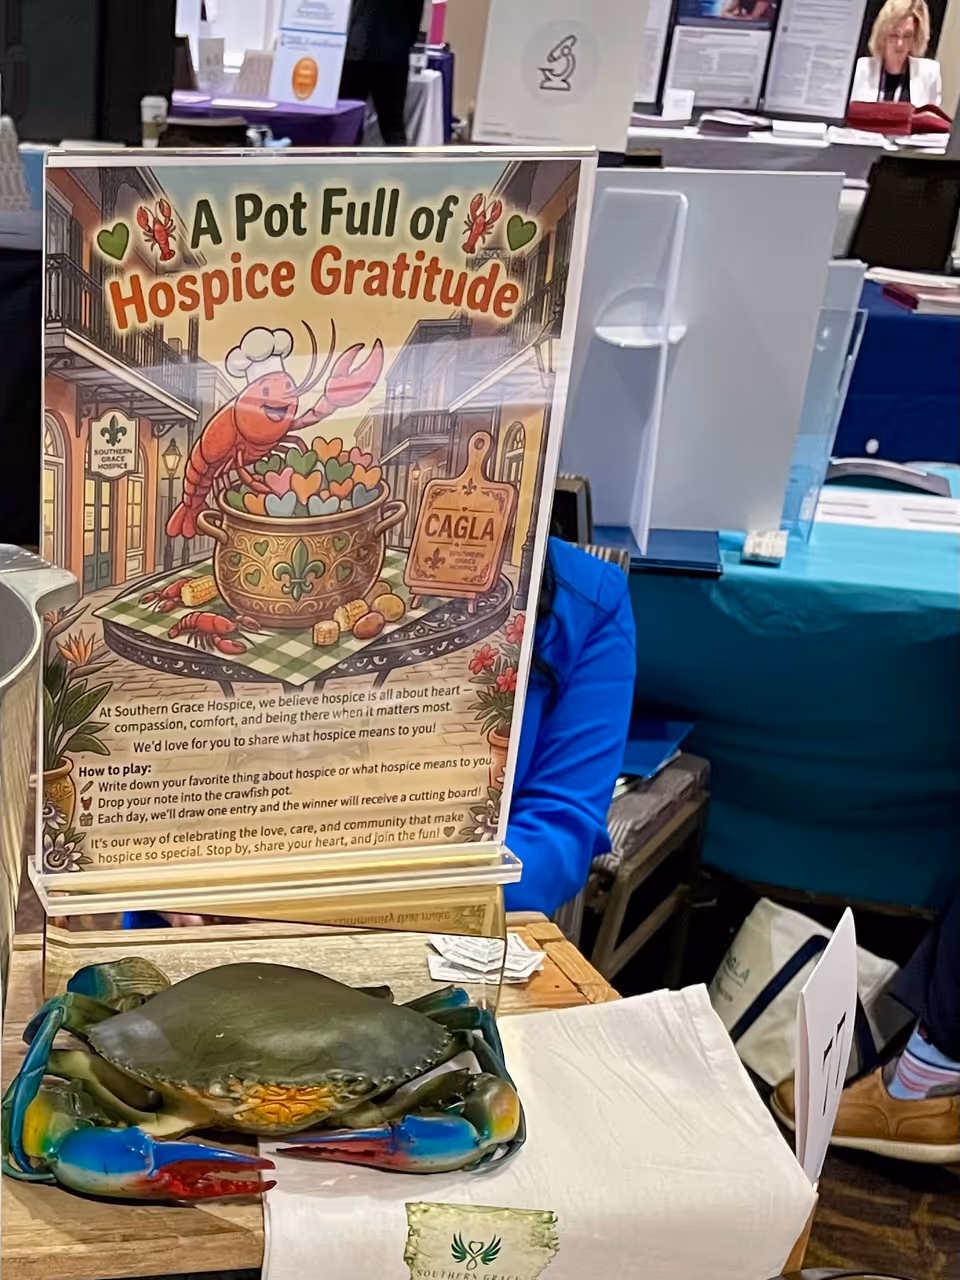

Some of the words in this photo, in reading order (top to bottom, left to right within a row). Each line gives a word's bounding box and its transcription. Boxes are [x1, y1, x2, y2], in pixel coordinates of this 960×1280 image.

[191, 199, 222, 248] A
[235, 192, 306, 241] Pot
[321, 188, 400, 237] Full
[410, 195, 459, 243] of
[109, 252, 295, 329] Hospice
[311, 245, 519, 318] Gratitude
[424, 513, 494, 541] CAGLA
[99, 707, 111, 718] At
[115, 705, 168, 717] Southern
[171, 702, 204, 714] Grace
[207, 699, 256, 713] Hospice,
[259, 699, 275, 708] we
[278, 694, 319, 707] believe
[322, 692, 365, 707] hospice
[368, 690, 376, 701] is
[380, 689, 393, 700] all
[396, 688, 428, 699] about
[431, 685, 460, 697] heart
[115, 719, 187, 733] compassion,
[190, 716, 238, 729] comfort,
[241, 714, 263, 725] and
[266, 712, 297, 725] being
[300, 707, 330, 720] there
[333, 706, 363, 719] when
[365, 705, 374, 716] it
[377, 704, 419, 715] matters
[423, 701, 453, 713] most.
[133, 740, 162, 753] We'd
[165, 739, 189, 751] love
[191, 737, 207, 749] for
[210, 738, 231, 750] you
[234, 736, 245, 747] to
[248, 733, 279, 745] share
[282, 730, 310, 743] what
[313, 728, 356, 743] hospice
[359, 727, 395, 737] means
[398, 725, 409, 735] to
[412, 723, 436, 737] you!
[79, 766, 105, 777] How
[108, 765, 120, 775] to
[123, 763, 152, 778] play:
[98, 779, 127, 792] Write
[130, 777, 159, 790] down
[162, 778, 186, 791] your
[189, 773, 230, 786] favorite
[233, 771, 259, 784] thing
[262, 768, 292, 781] about
[296, 765, 336, 780] hospice
[339, 765, 349, 775] or
[352, 762, 378, 774] what
[381, 759, 420, 774] hospice
[423, 758, 457, 770] means
[460, 756, 470, 767] to
[473, 756, 494, 769] you.
[98, 797, 124, 810] Drop
[127, 796, 151, 808] your
[154, 792, 178, 804] note
[181, 790, 202, 802] into
[205, 788, 222, 800] the
[225, 786, 269, 799] crawfish
[272, 786, 292, 798] pot.
[98, 812, 123, 824] Each
[126, 810, 148, 823] day,
[151, 807, 176, 820] we'll
[179, 806, 205, 819] draw
[207, 806, 227, 816] one
[230, 803, 257, 816] entry
[260, 800, 280, 813] and
[283, 798, 299, 810] the
[302, 797, 337, 808] winner
[341, 794, 359, 806] will
[361, 792, 398, 805] receive
[400, 793, 406, 802] a
[409, 789, 445, 802] cutting
[448, 787, 481, 799] board!
[91, 838, 108, 849] It's
[111, 837, 130, 847] our
[133, 835, 157, 848] way
[159, 832, 170, 844] of
[173, 829, 237, 844] celebrating
[240, 827, 257, 839] the
[261, 824, 287, 837] love,
[290, 823, 317, 835] care,
[320, 820, 340, 832] and
[344, 816, 406, 831] community
[409, 814, 431, 825] that
[434, 812, 464, 824] make
[98, 849, 142, 864] hospice
[145, 849, 158, 859] so
[161, 844, 202, 860] special.
[206, 843, 232, 857] Stop
[235, 842, 251, 855] by,
[254, 840, 284, 853] share
[288, 839, 312, 852] your
[315, 834, 348, 848] heart,
[351, 832, 372, 845] and
[374, 831, 394, 845] join
[398, 829, 416, 841] the
[419, 827, 440, 840] fun!
